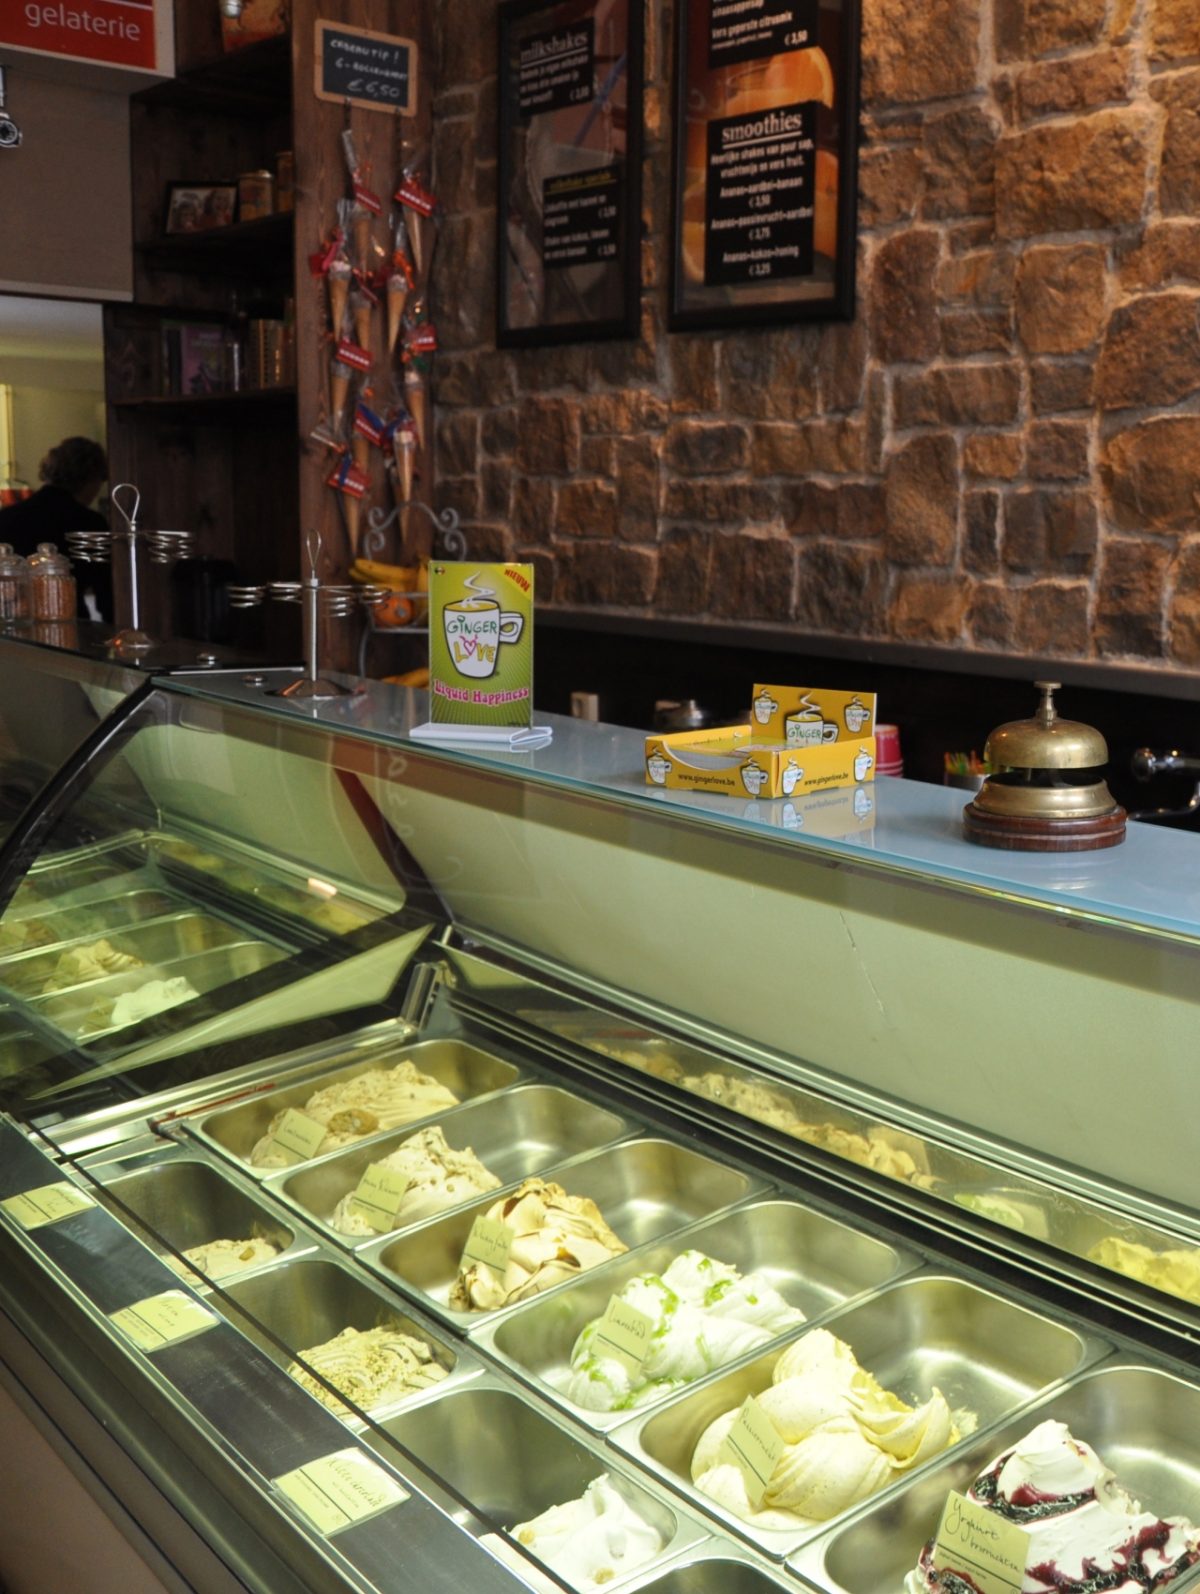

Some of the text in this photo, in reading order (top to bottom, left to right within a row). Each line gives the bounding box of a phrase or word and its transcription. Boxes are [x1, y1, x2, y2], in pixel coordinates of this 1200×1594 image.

[25, 3, 140, 41] gelaterie
[722, 111, 802, 142] smoothies
[447, 615, 498, 635] GINGER
[434, 679, 529, 706] Liquid Happiness
[678, 774, 735, 786] www.gingerlove.be
